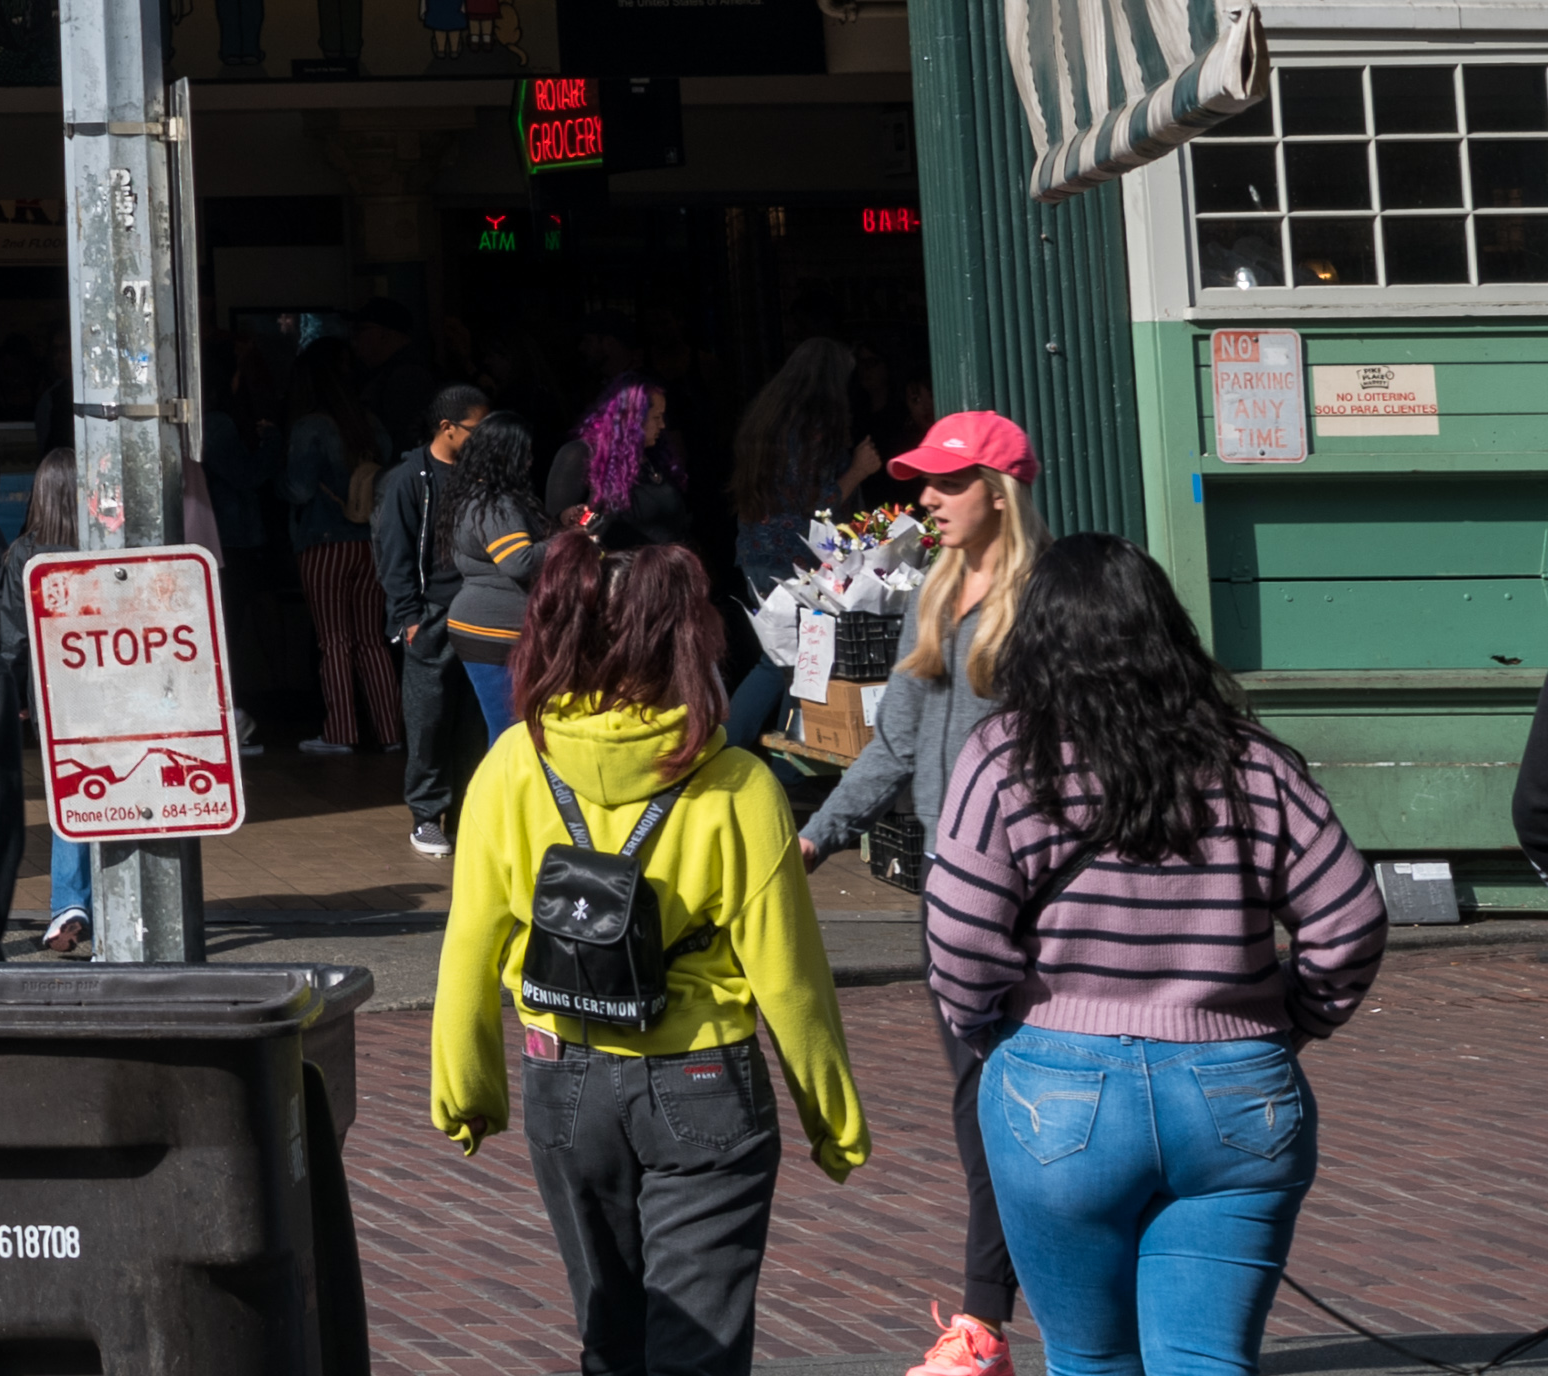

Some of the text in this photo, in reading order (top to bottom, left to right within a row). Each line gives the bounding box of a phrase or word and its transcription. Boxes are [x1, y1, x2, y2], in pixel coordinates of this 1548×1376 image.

[529, 115, 603, 163] GROCERY
[479, 231, 516, 251] ATM
[1220, 334, 1253, 359] NO
[1220, 371, 1295, 391] PARKING
[1336, 392, 1416, 402] NO LOITERING
[1234, 399, 1284, 419] ANY
[1314, 404, 1438, 415] SOLO PARA CLIENTES
[1234, 428, 1288, 448] TIME
[60, 624, 198, 670] STOPS
[65, 802, 230, 824] Phone 684-5444
[522, 979, 570, 1010] OPENING
